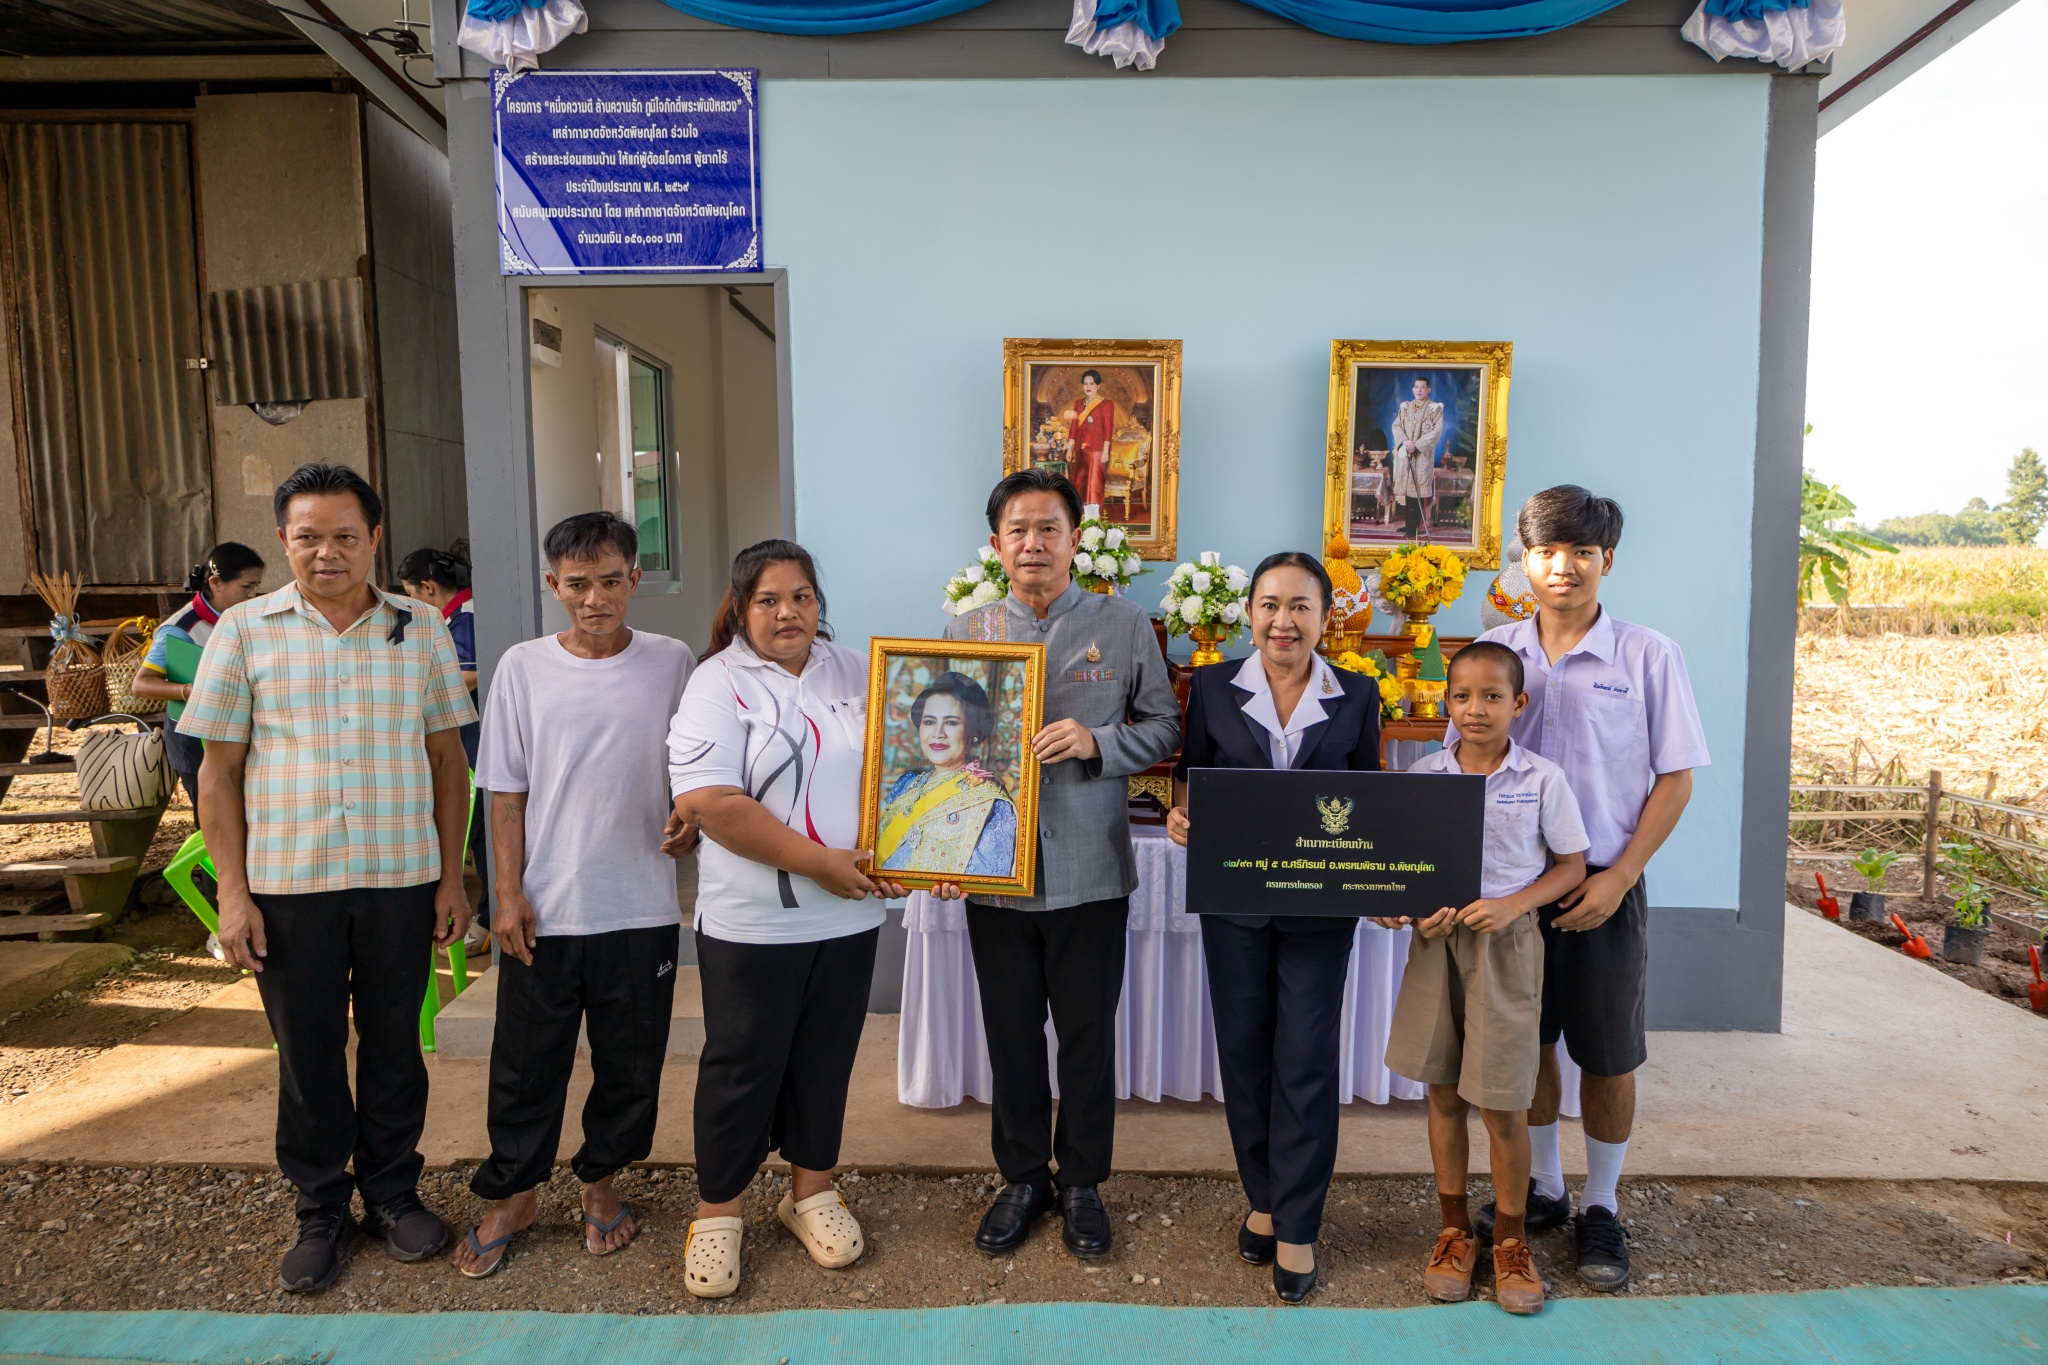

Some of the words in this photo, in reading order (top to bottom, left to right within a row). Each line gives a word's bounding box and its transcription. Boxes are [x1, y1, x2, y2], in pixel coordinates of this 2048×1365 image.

[506, 98, 541, 113] โครงการ
[596, 99, 642, 113] ล้านความรัก
[553, 124, 667, 142] เหล่ากาชาดจังหวัดพิษณุโลก
[671, 123, 698, 138] ร่วมใจ
[525, 151, 616, 165] สร้างและซ่อมแซมบ้าน
[618, 150, 691, 168] ให้แก่ผู้ด้อยโอกาส
[694, 149, 727, 168] ผู้ยากไร้
[566, 179, 641, 193] ประจำปีงบประมาณ
[644, 181, 662, 192] พ.ศ.
[665, 181, 689, 193] ๒๕๖๙
[512, 204, 602, 221] สนับสนุนงบประมาณ
[605, 203, 621, 218] โดย
[625, 202, 746, 220] เหล่ากาชาดจังหวัดพิษณุโลก
[578, 231, 622, 244] จำนวนเงิน
[624, 233, 663, 245] ๑๕๐,๐๐๐
[666, 232, 682, 244] บาท
[1296, 837, 1373, 850] สำเนาทะเบียนบ้าน
[1255, 857, 1269, 871] หมู่
[1272, 861, 1278, 869] ๕
[1281, 858, 1326, 870] ต.ศรีภิรมย์
[1329, 859, 1386, 871] อ.พรหมพิราม
[1389, 860, 1435, 873] จ.พิษณุโลก
[1266, 880, 1323, 890] กรมการปกครอง
[1342, 882, 1406, 892] กระทรวงมหาดไทย
